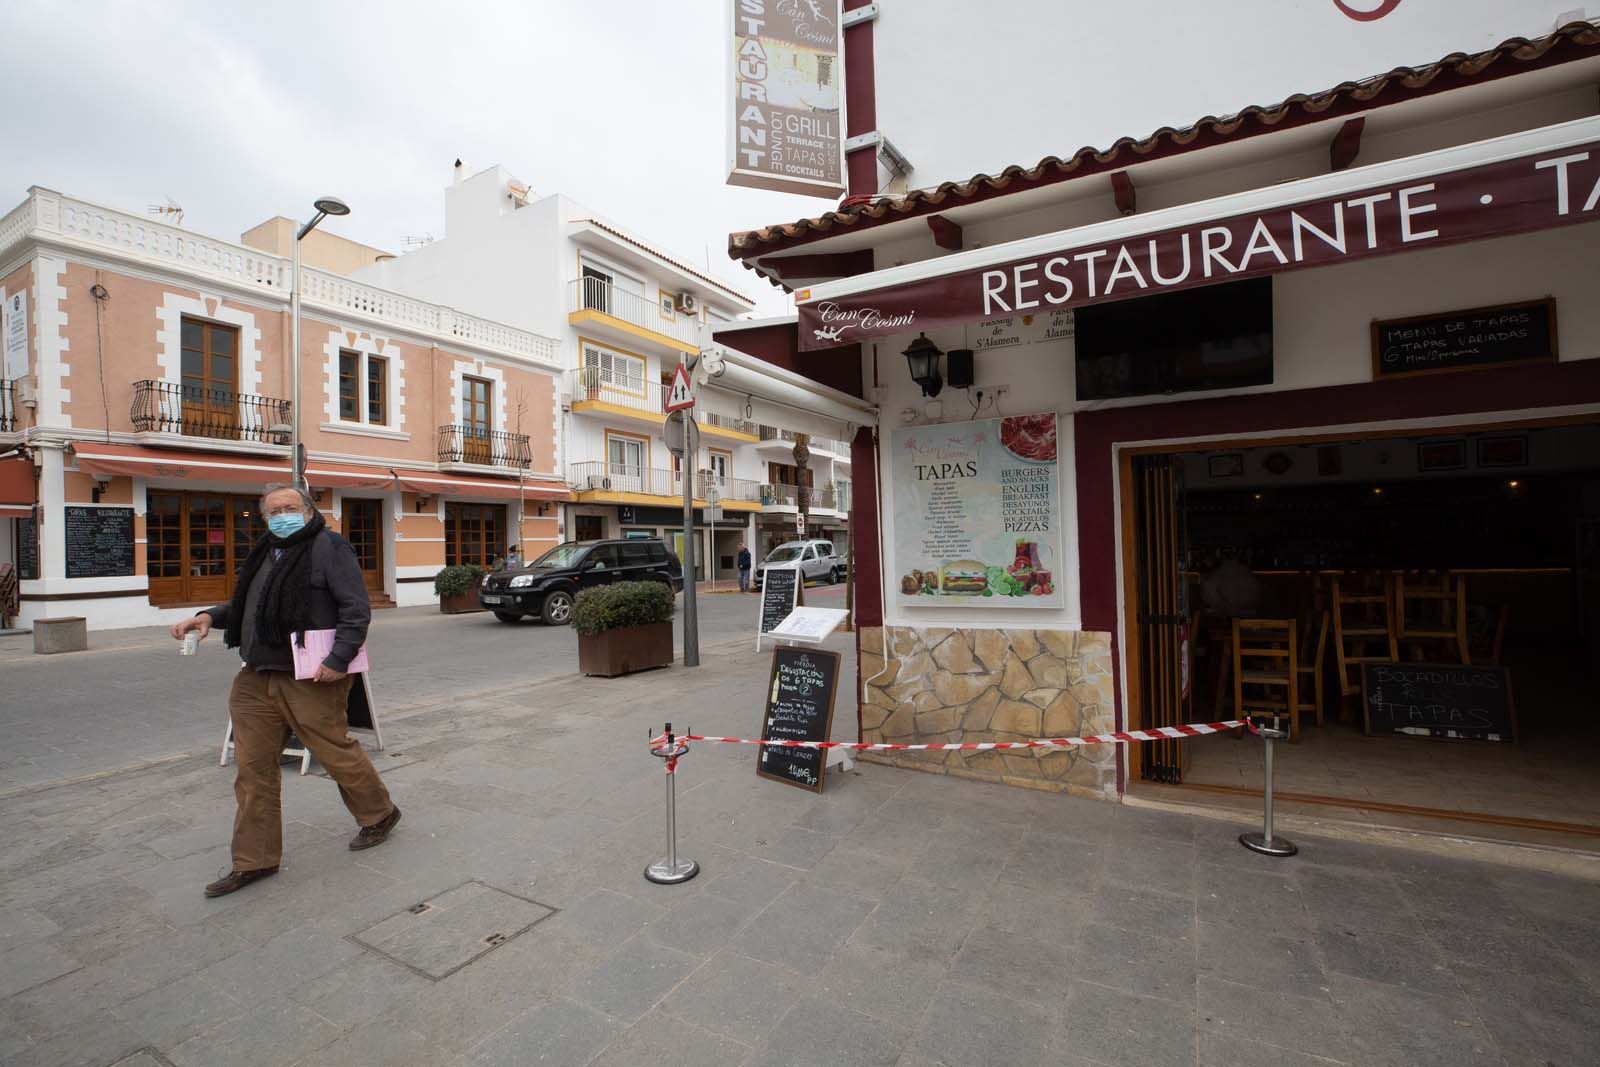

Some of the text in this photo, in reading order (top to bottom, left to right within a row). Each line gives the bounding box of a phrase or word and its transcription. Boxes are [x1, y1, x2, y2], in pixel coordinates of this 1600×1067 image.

[785, 114, 837, 140] GRILL
[770, 111, 783, 171] LOUNGE
[786, 135, 824, 149] TERRACE
[786, 147, 825, 166] TAPAS
[785, 164, 825, 178] COCKTAILS
[982, 183, 1439, 315] RESTAURANTE
[818, 301, 915, 329] Can Cosmi
[1445, 322, 1465, 333] DE
[1473, 313, 1529, 328] TAPAS
[993, 326, 1003, 336] de
[1402, 339, 1447, 351] TAPAS
[1458, 329, 1527, 346] VARIADAS
[914, 461, 977, 480] TAPAS
[1001, 467, 1050, 478] BURGERS
[1002, 483, 1049, 494] ENGLISH
[1003, 492, 1049, 501] BREAKFAST
[1003, 500, 1050, 509] DESAYUNOS
[1003, 507, 1050, 516] COCKTAILS
[1003, 515, 1050, 523] BOCADILLOS
[1005, 522, 1049, 533] PIZZAS
[1383, 702, 1496, 729] TAPAS
